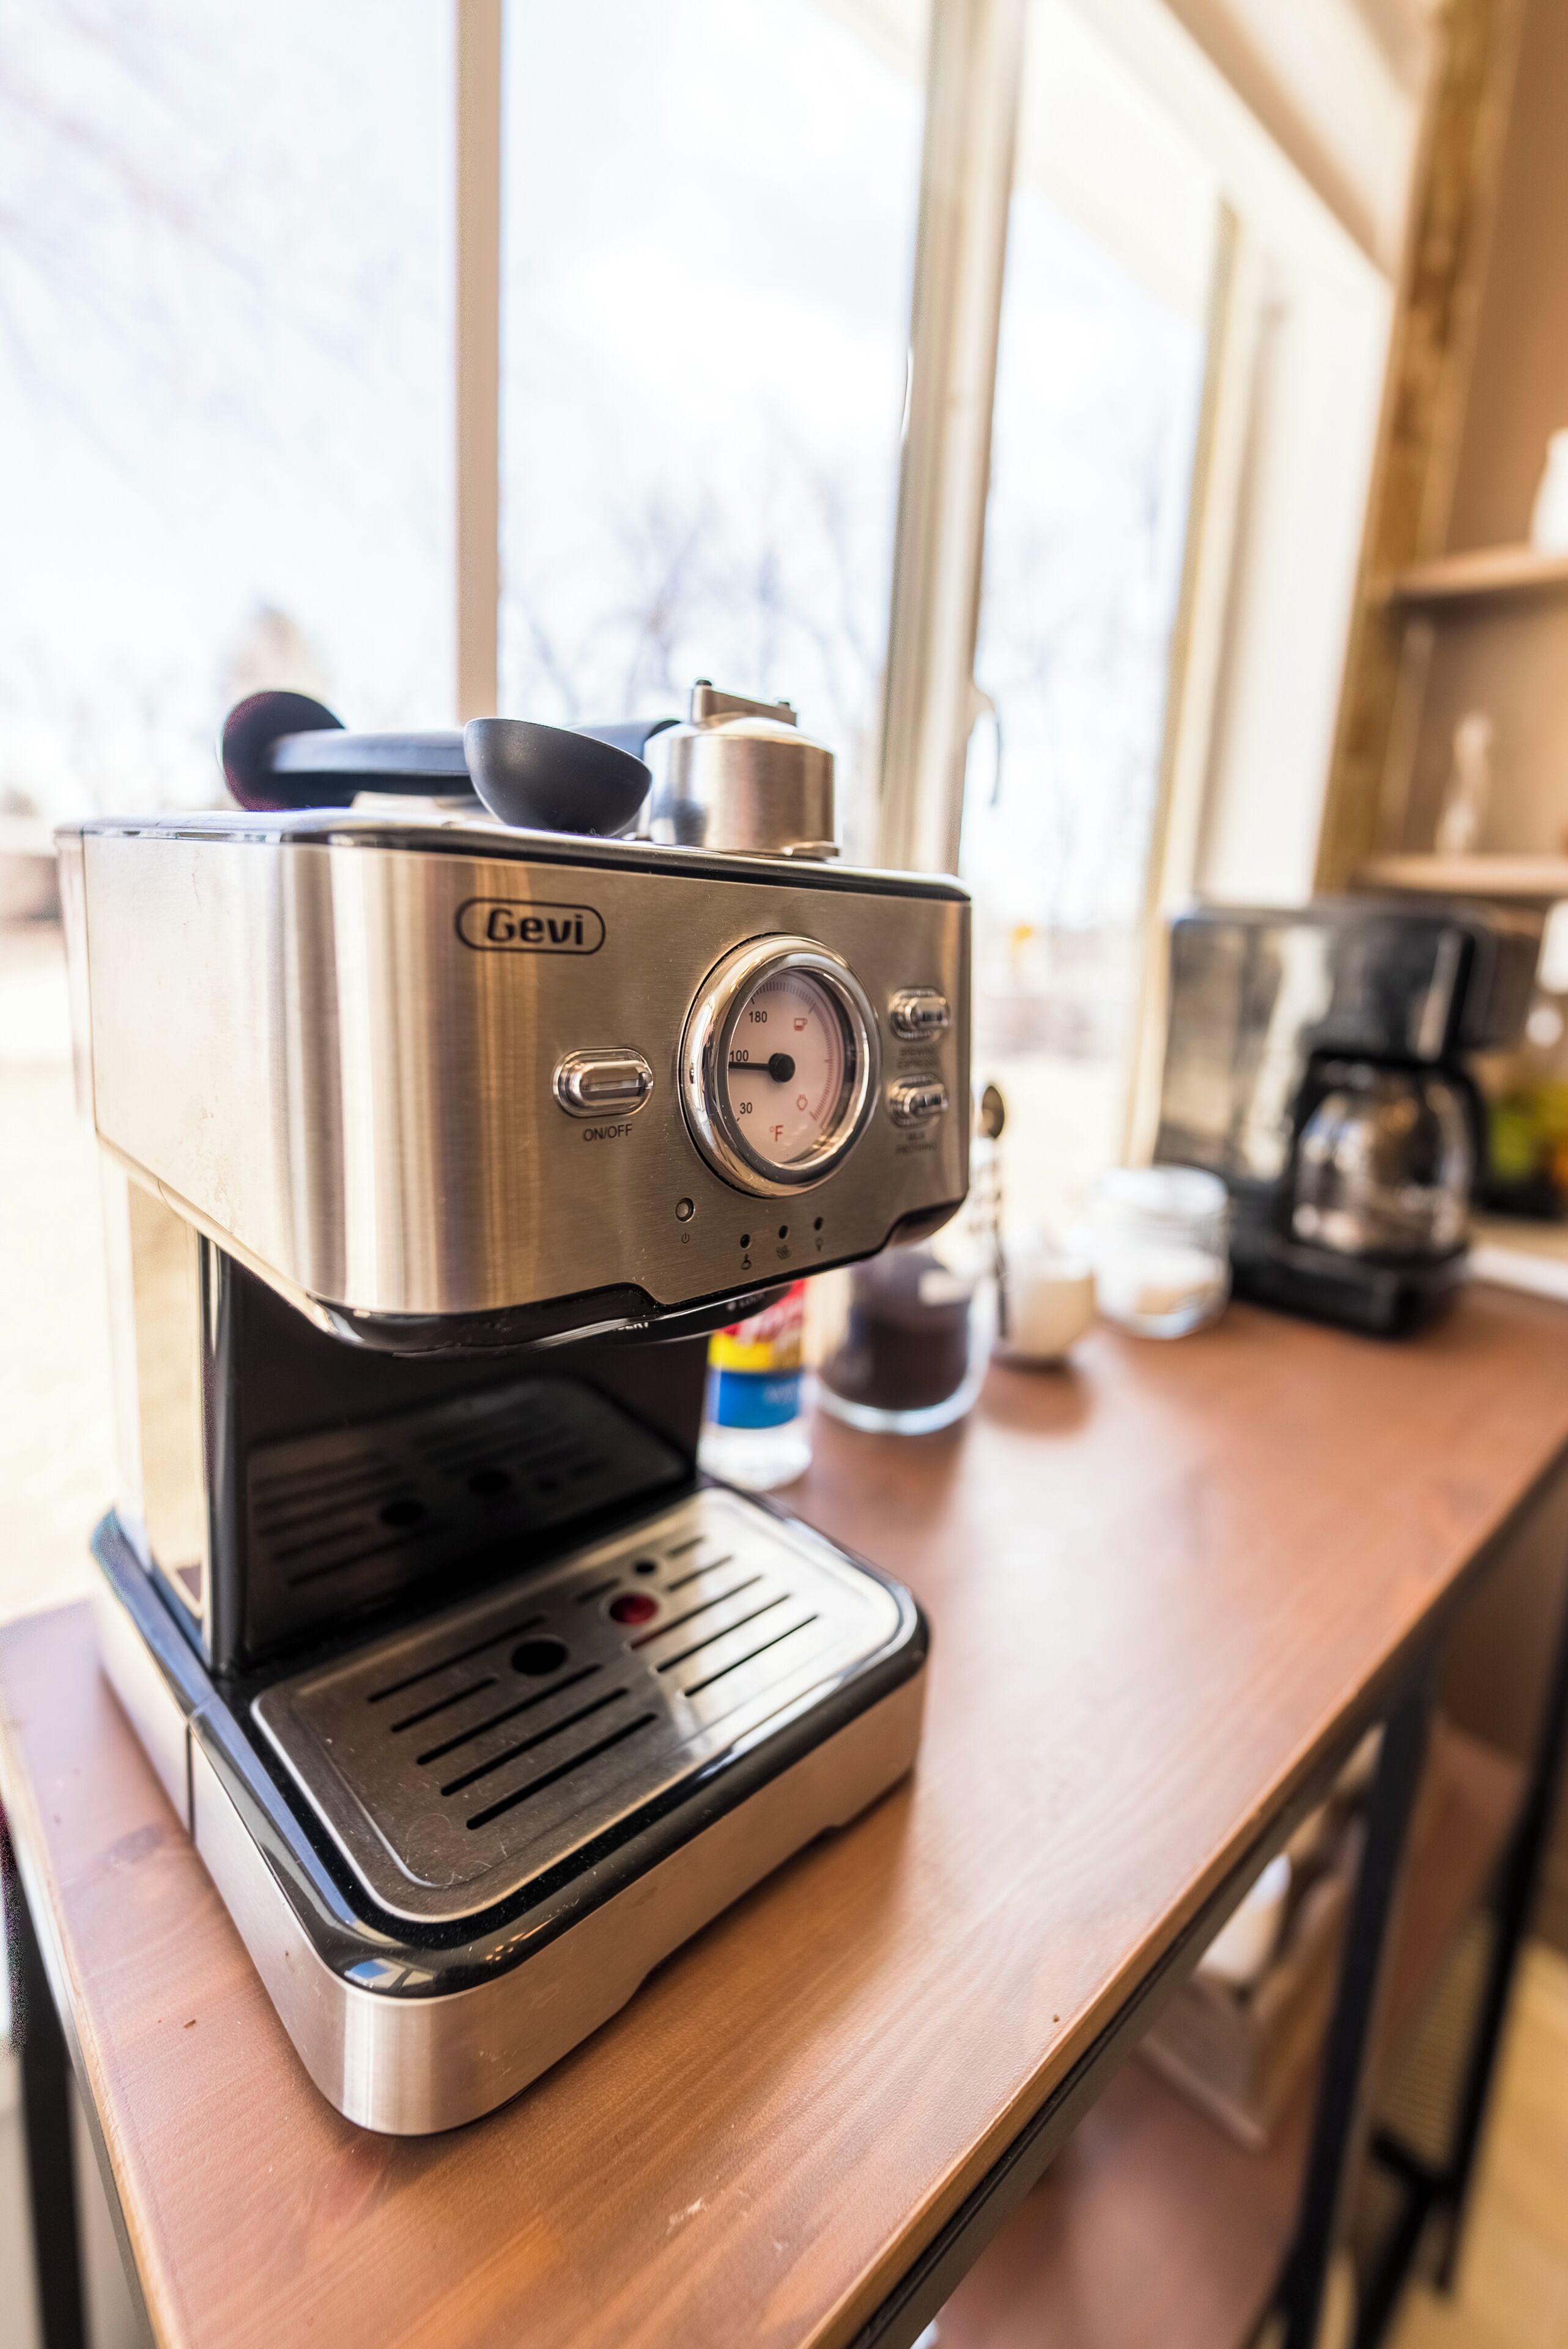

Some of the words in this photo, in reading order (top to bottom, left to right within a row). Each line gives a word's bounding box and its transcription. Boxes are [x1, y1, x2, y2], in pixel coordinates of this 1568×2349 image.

[487, 908, 585, 945] Gevi
[749, 1011, 767, 1023] 180
[730, 1050, 749, 1062] 100
[739, 1102, 753, 1115] 30
[583, 1123, 632, 1141] ON/OFF
